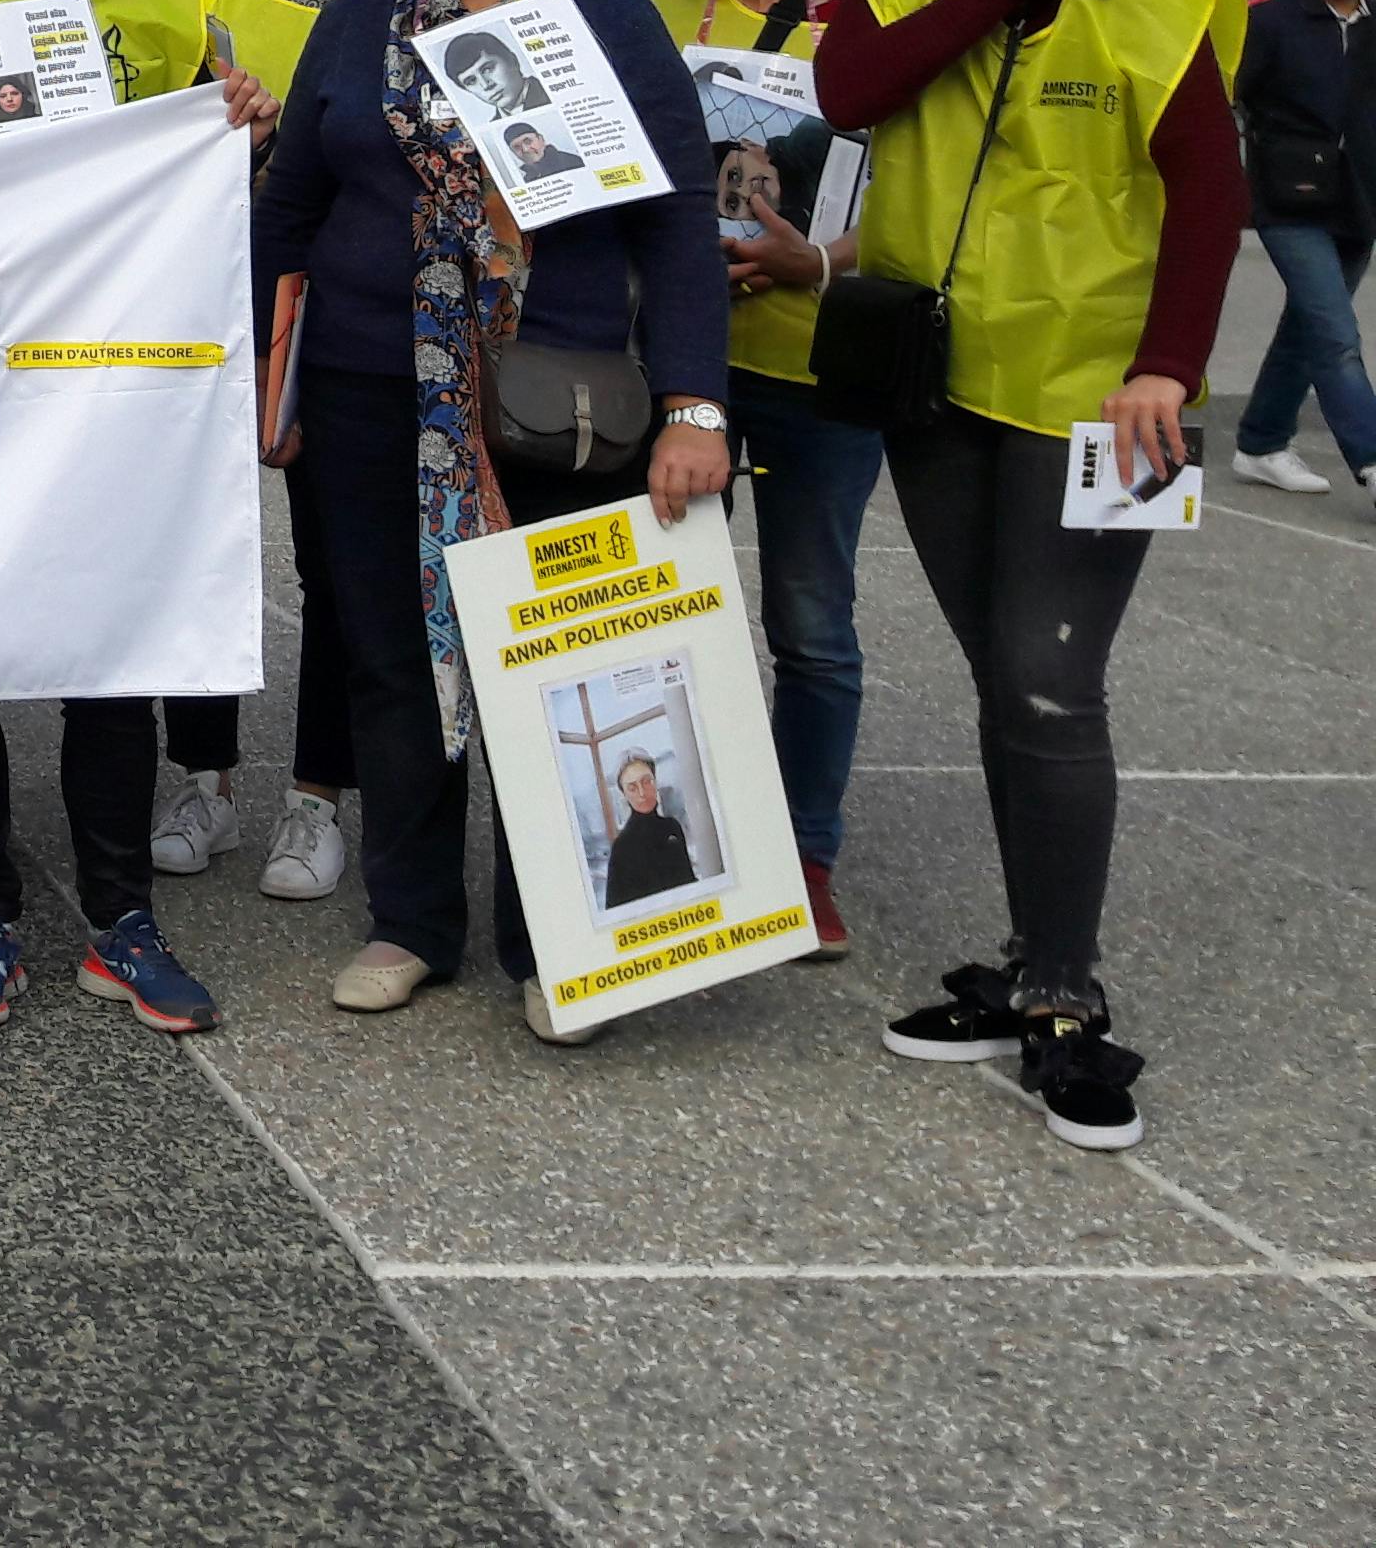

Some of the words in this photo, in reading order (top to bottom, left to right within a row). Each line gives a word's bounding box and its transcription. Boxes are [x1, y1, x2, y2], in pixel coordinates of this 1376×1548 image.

[510, 12, 534, 27] Quand
[518, 25, 538, 39] était
[546, 34, 572, 47] rêvait
[1041, 81, 1099, 98] AMNESTY
[13, 350, 29, 361] ET
[32, 349, 64, 360] BIEN
[67, 348, 134, 360] D'AUTRES
[534, 531, 598, 565] AMNESTY
[537, 553, 604, 580] INTERNATIONAL
[518, 604, 545, 626] EN
[550, 575, 651, 618] HOMMAGE
[656, 566, 670, 589] À
[504, 638, 558, 668] ANNA
[564, 590, 720, 649] POLITKOVSKAÏA
[618, 904, 717, 948] assassinée
[560, 984, 576, 1002] le
[579, 977, 589, 994] 7
[596, 954, 664, 989] octobre
[668, 938, 709, 966] 2006
[715, 934, 726, 951] à
[730, 911, 800, 946] Moscou
